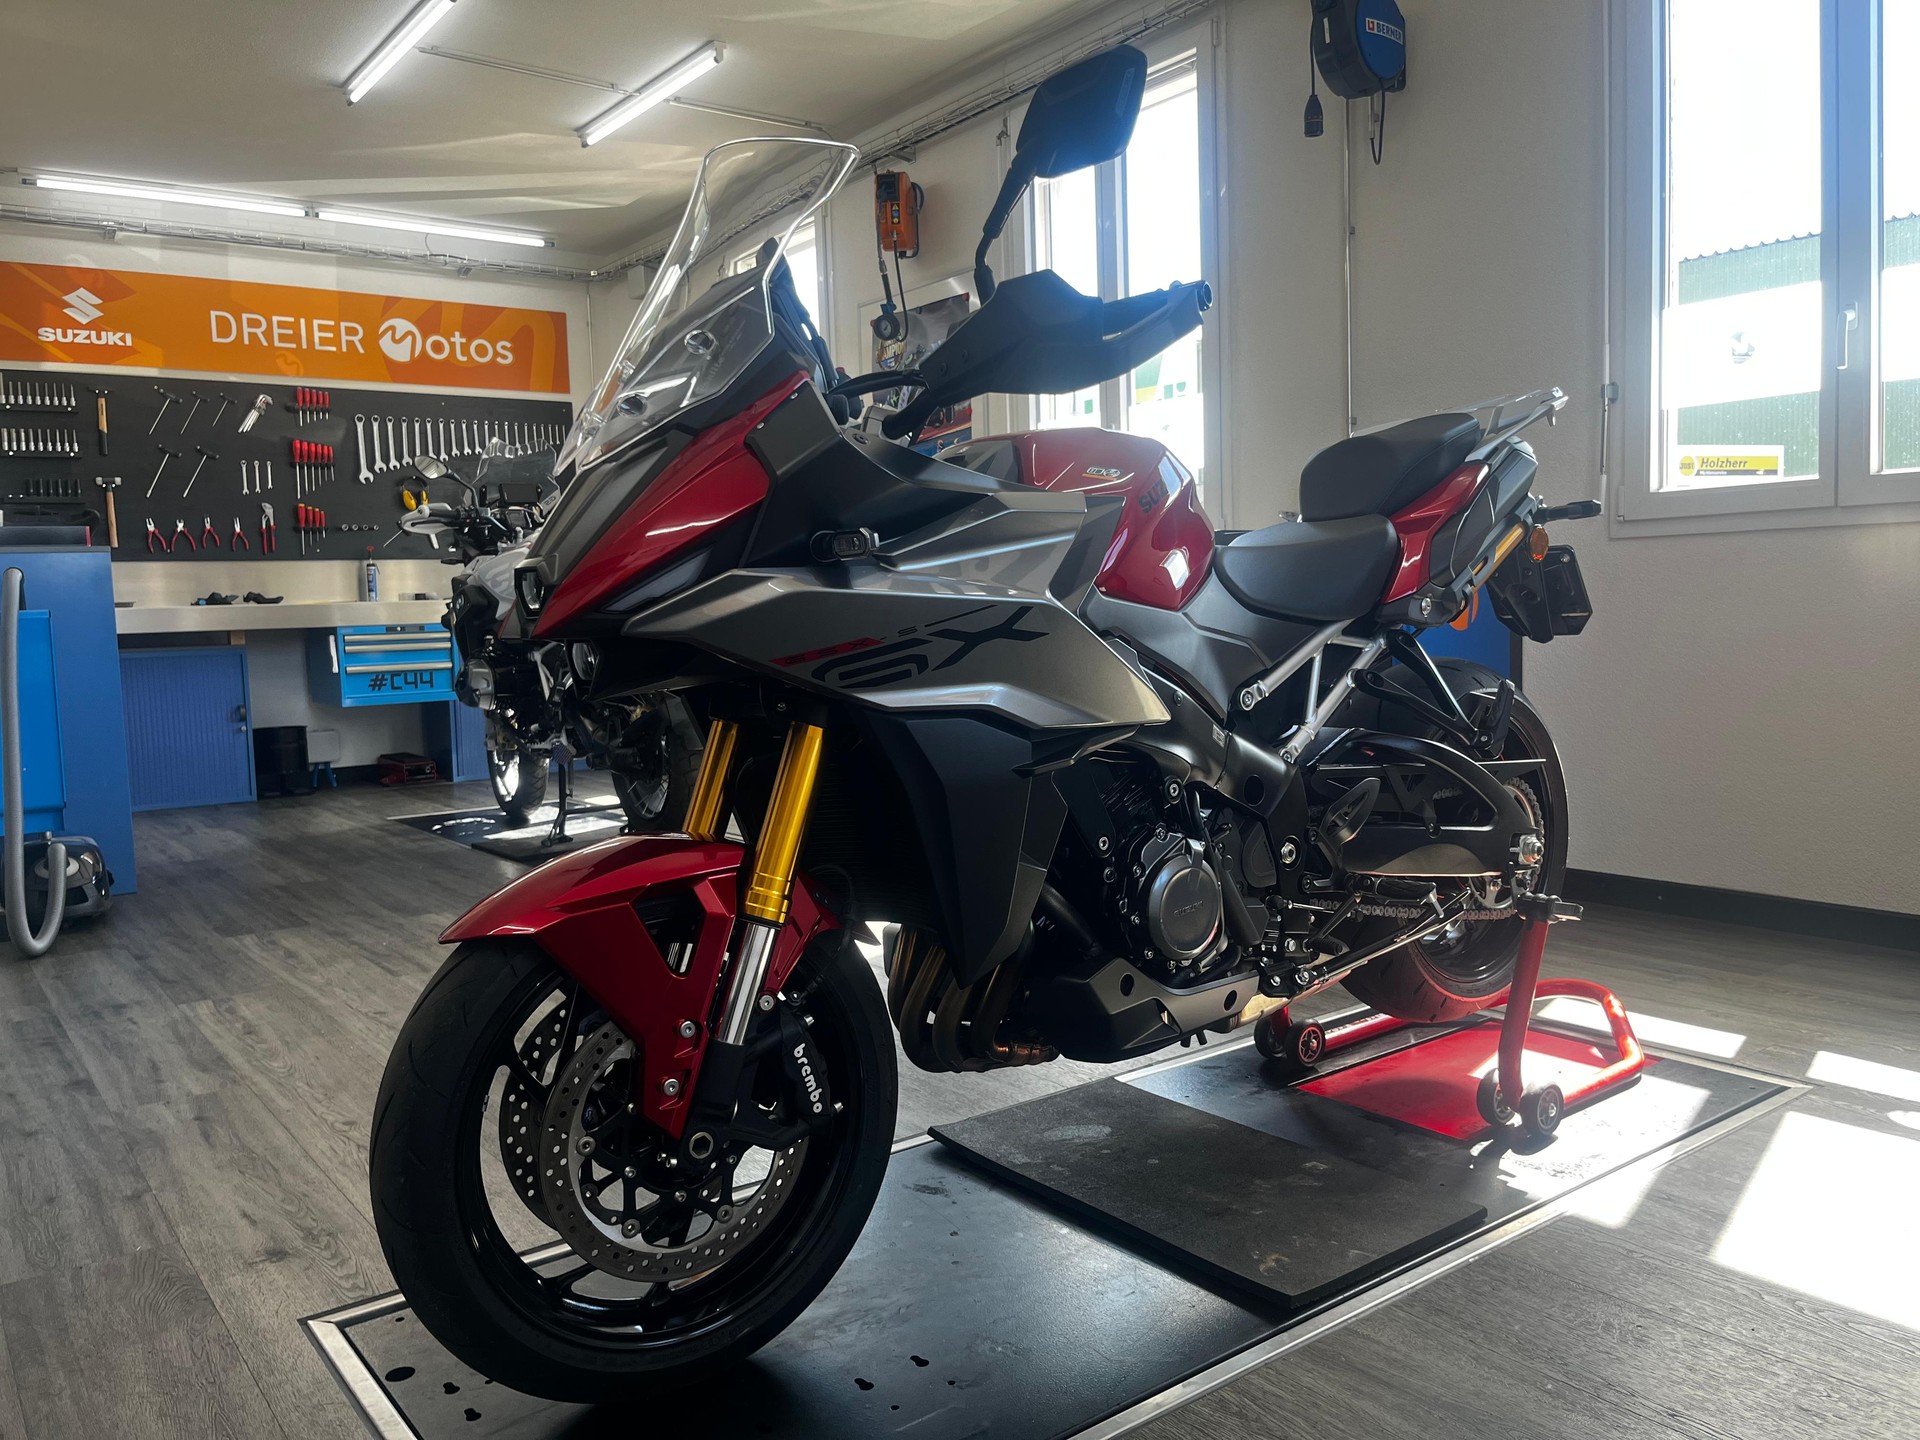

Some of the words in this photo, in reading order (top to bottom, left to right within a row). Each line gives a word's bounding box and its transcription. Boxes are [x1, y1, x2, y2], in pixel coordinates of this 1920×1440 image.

[1376, 22, 1402, 42] BERNER
[38, 327, 132, 346] SUZUKI
[210, 310, 365, 354] DREIER
[379, 317, 514, 364] Motos
[1701, 458, 1748, 469] Holzherr
[368, 671, 434, 691] #C44
[793, 1043, 822, 1113] brembo
